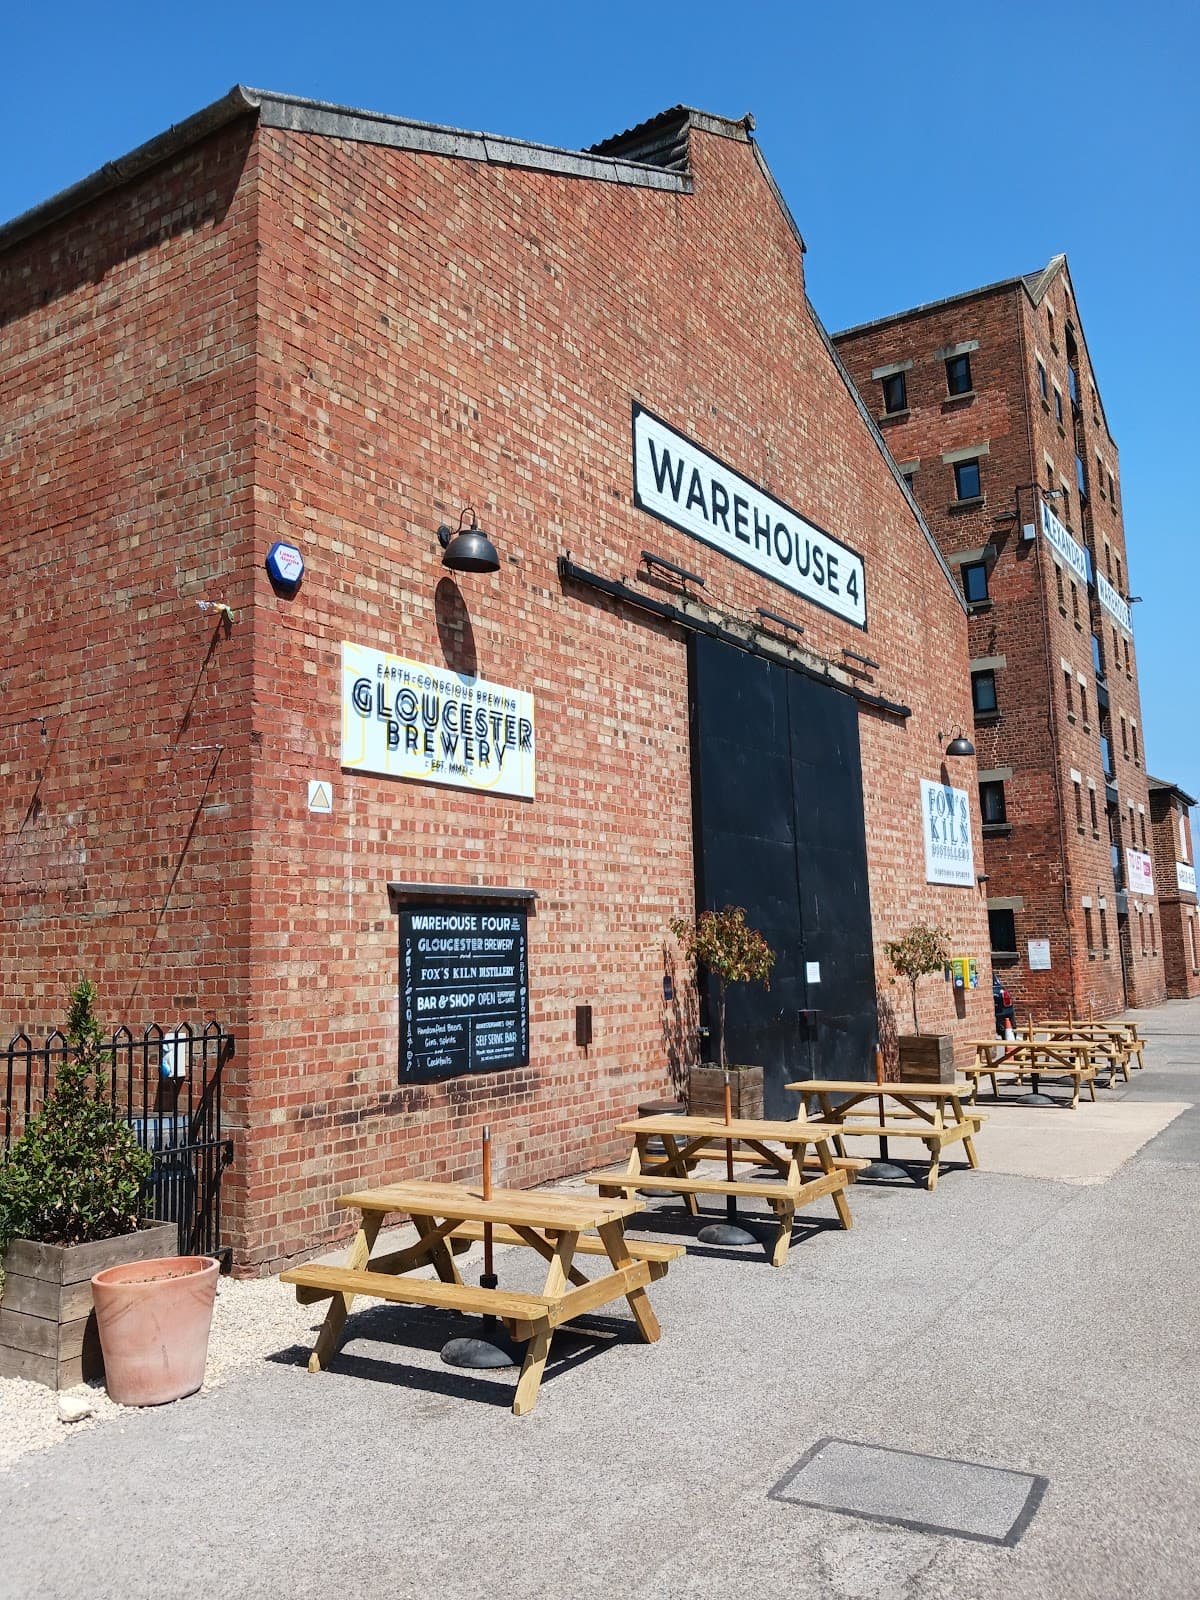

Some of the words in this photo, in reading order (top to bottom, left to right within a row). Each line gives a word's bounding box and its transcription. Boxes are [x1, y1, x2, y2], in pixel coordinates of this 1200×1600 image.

[648, 437, 840, 596] WAREHOUSE
[846, 568, 860, 606] 4
[1043, 504, 1087, 579] ALEXANDRA
[351, 677, 533, 750] GLOUCESTER
[476, 689, 517, 713] BREWING
[386, 719, 507, 768] BREWERY
[928, 787, 968, 821] FOX'S
[930, 815, 969, 847] KILN
[411, 915, 477, 931] WAREHOUSE
[481, 916, 511, 931] FOUR
[417, 937, 484, 952] GLOUCESTER
[484, 938, 514, 951] BREWERY
[421, 967, 450, 981] FOX'S
[452, 966, 477, 979] KILN
[479, 965, 516, 978] DISTILLERY
[417, 996, 437, 1011] BAR
[438, 994, 449, 1009] &
[449, 993, 476, 1008] SHOP
[477, 991, 496, 1006] OPEN
[475, 1034, 488, 1047] SELF
[487, 1033, 504, 1046] SERVE
[504, 1031, 518, 1044] BAR
